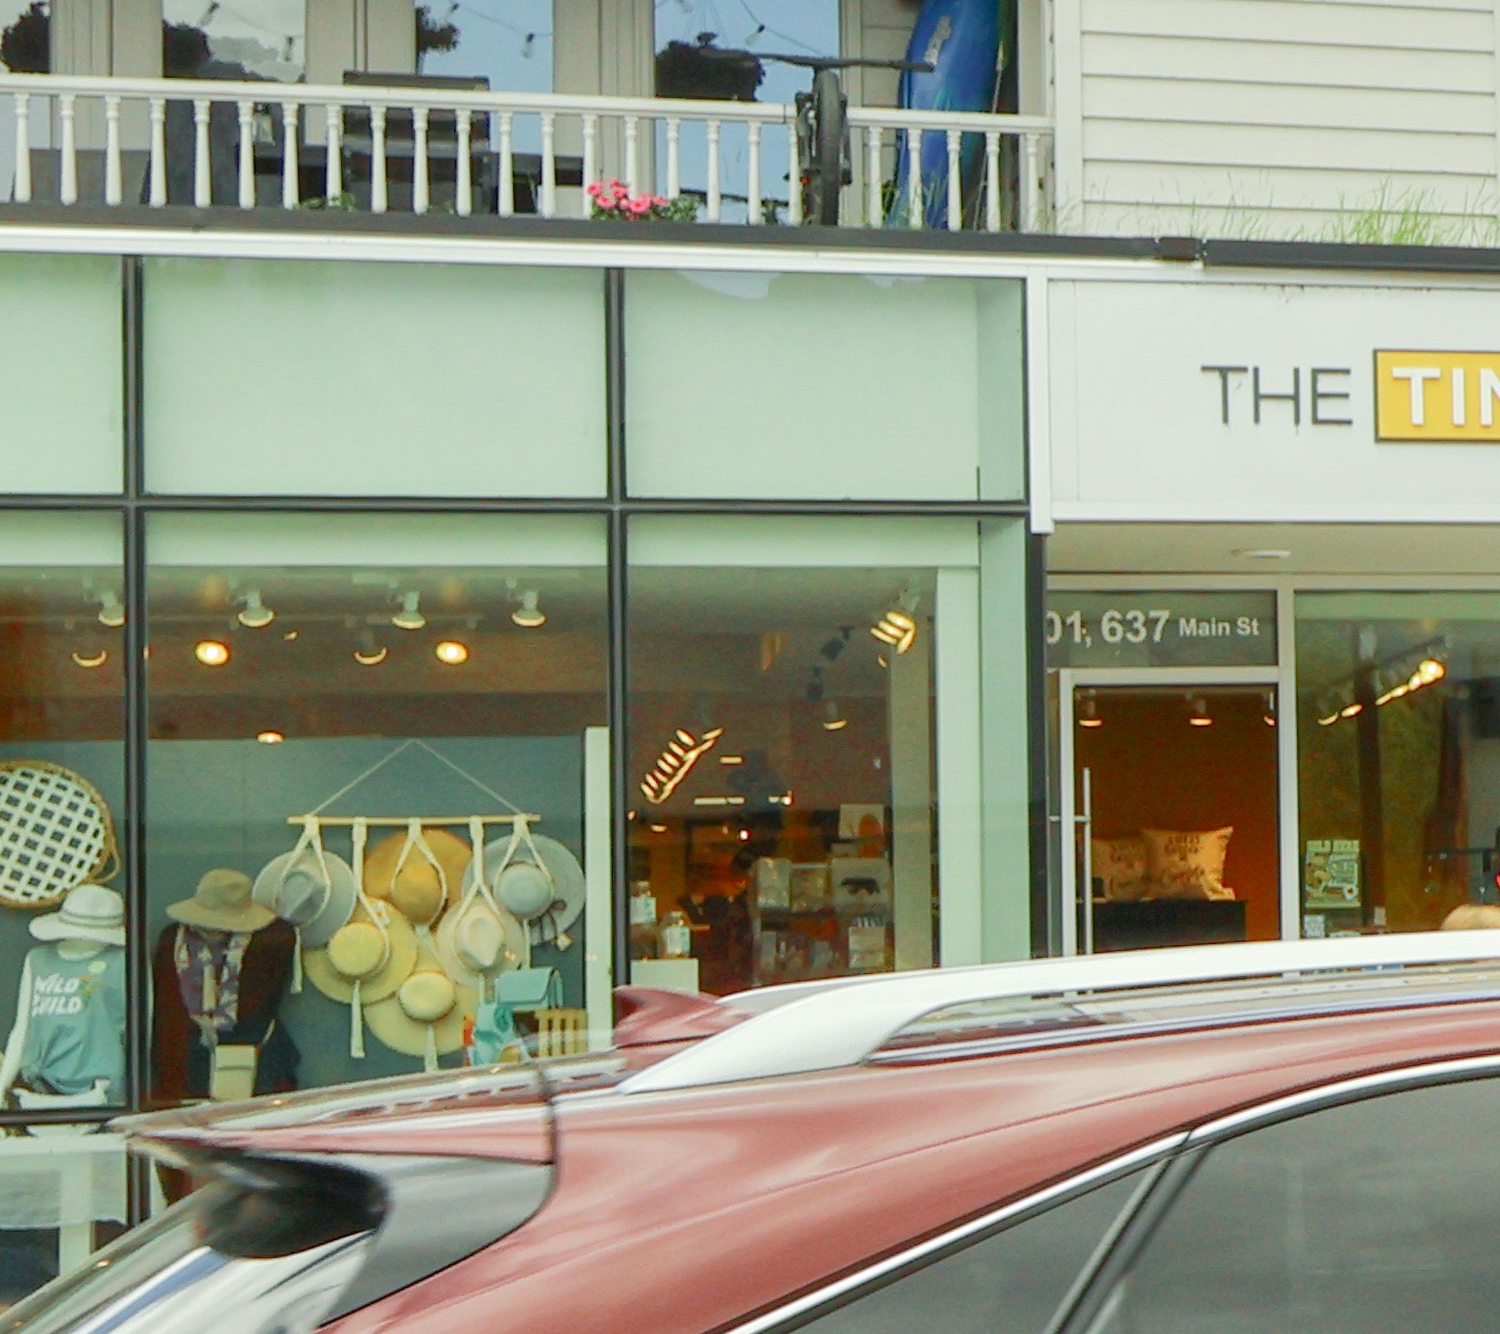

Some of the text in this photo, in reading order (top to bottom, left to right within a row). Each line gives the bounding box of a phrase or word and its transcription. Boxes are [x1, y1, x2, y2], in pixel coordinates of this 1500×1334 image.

[1201, 366, 1353, 426] THE
[1101, 609, 1170, 643] 637
[1179, 617, 1231, 637] Main
[1236, 617, 1260, 636] St
[34, 973, 80, 994] WILD
